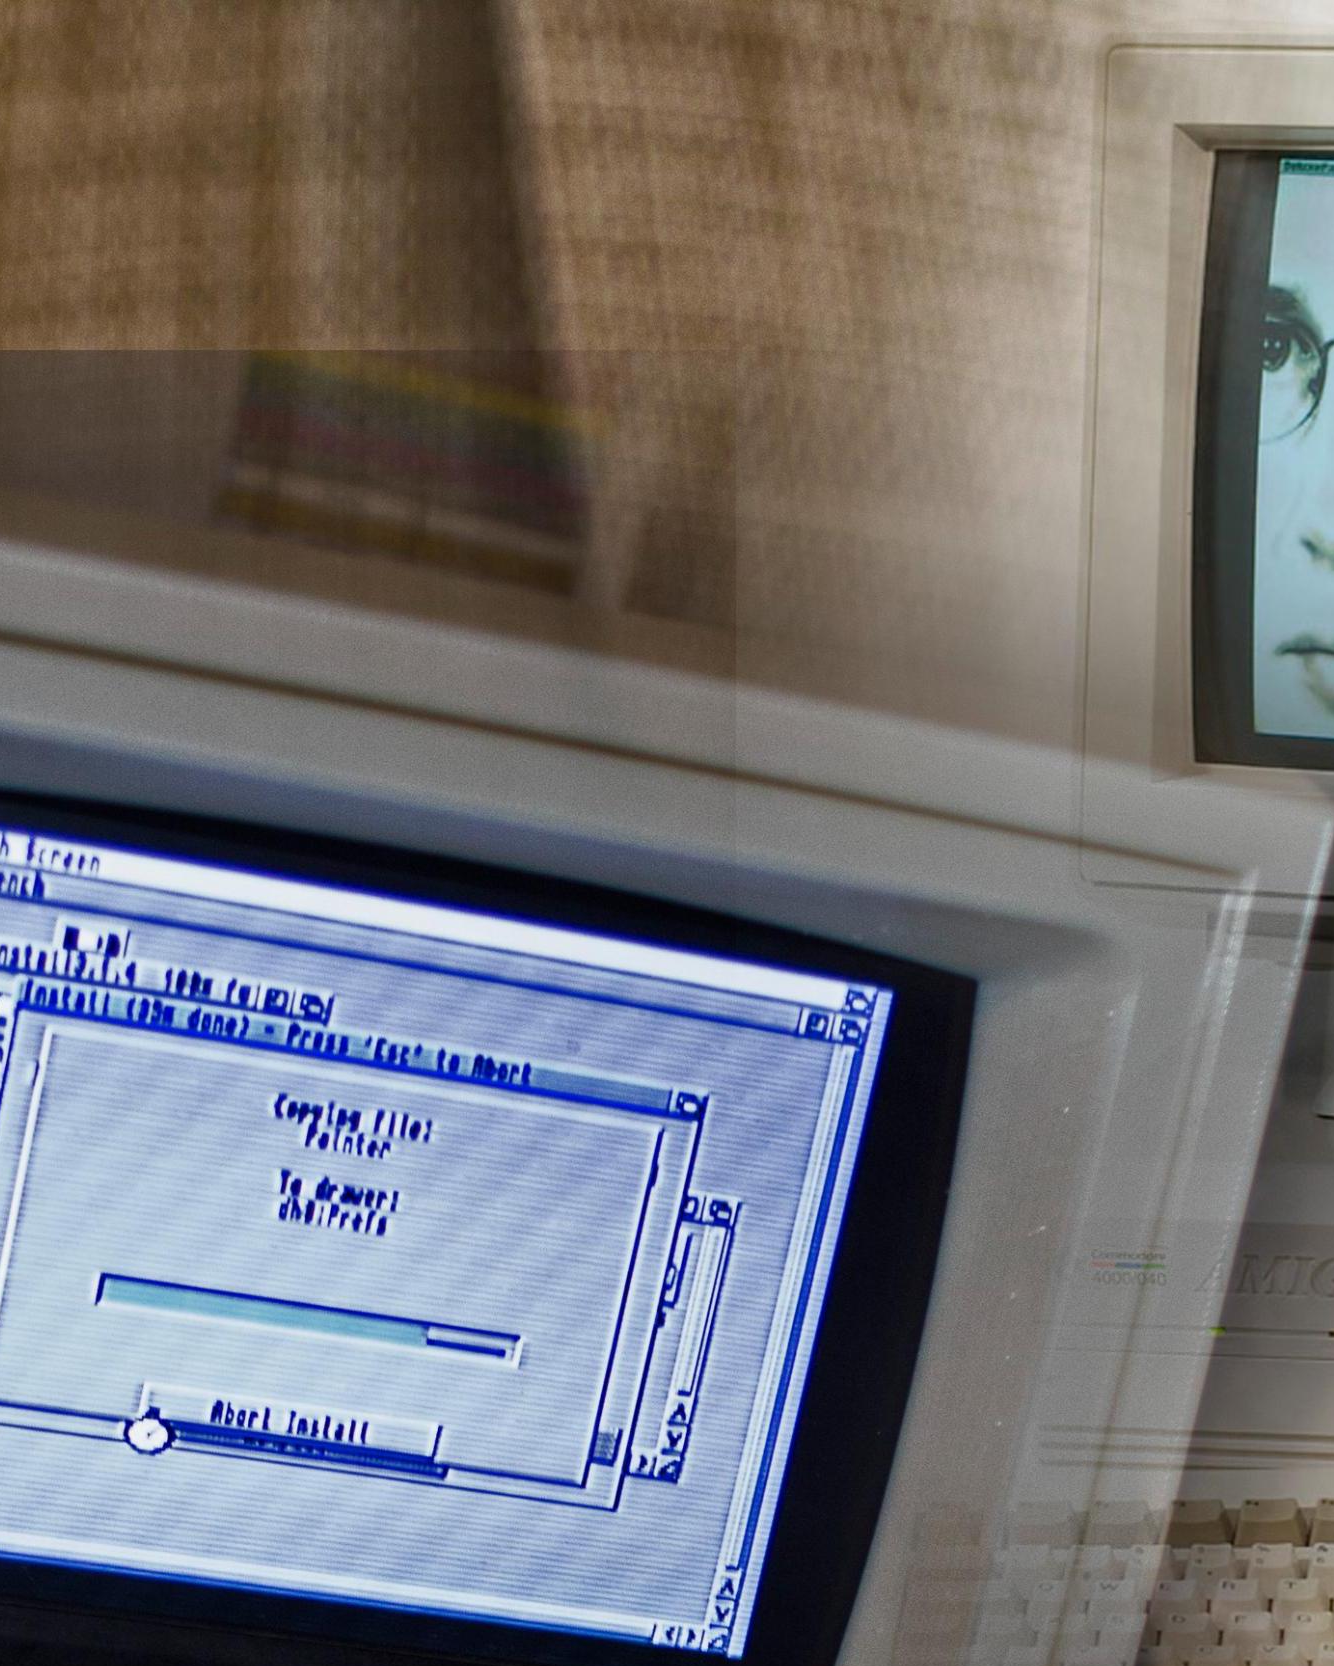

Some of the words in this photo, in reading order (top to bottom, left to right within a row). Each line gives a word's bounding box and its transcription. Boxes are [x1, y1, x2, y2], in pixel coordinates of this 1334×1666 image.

[26, 834, 100, 873] Screen
[24, 977, 109, 1016] Install
[286, 1022, 349, 1057] Press
[436, 1048, 460, 1075] to
[471, 1053, 533, 1086] Abort
[273, 1092, 362, 1133] Copying
[304, 1120, 392, 1160] Pointer
[279, 1168, 303, 1197] To
[315, 1175, 400, 1213] drawer:
[210, 1399, 271, 1432] Abort
[286, 1410, 370, 1445] Install
